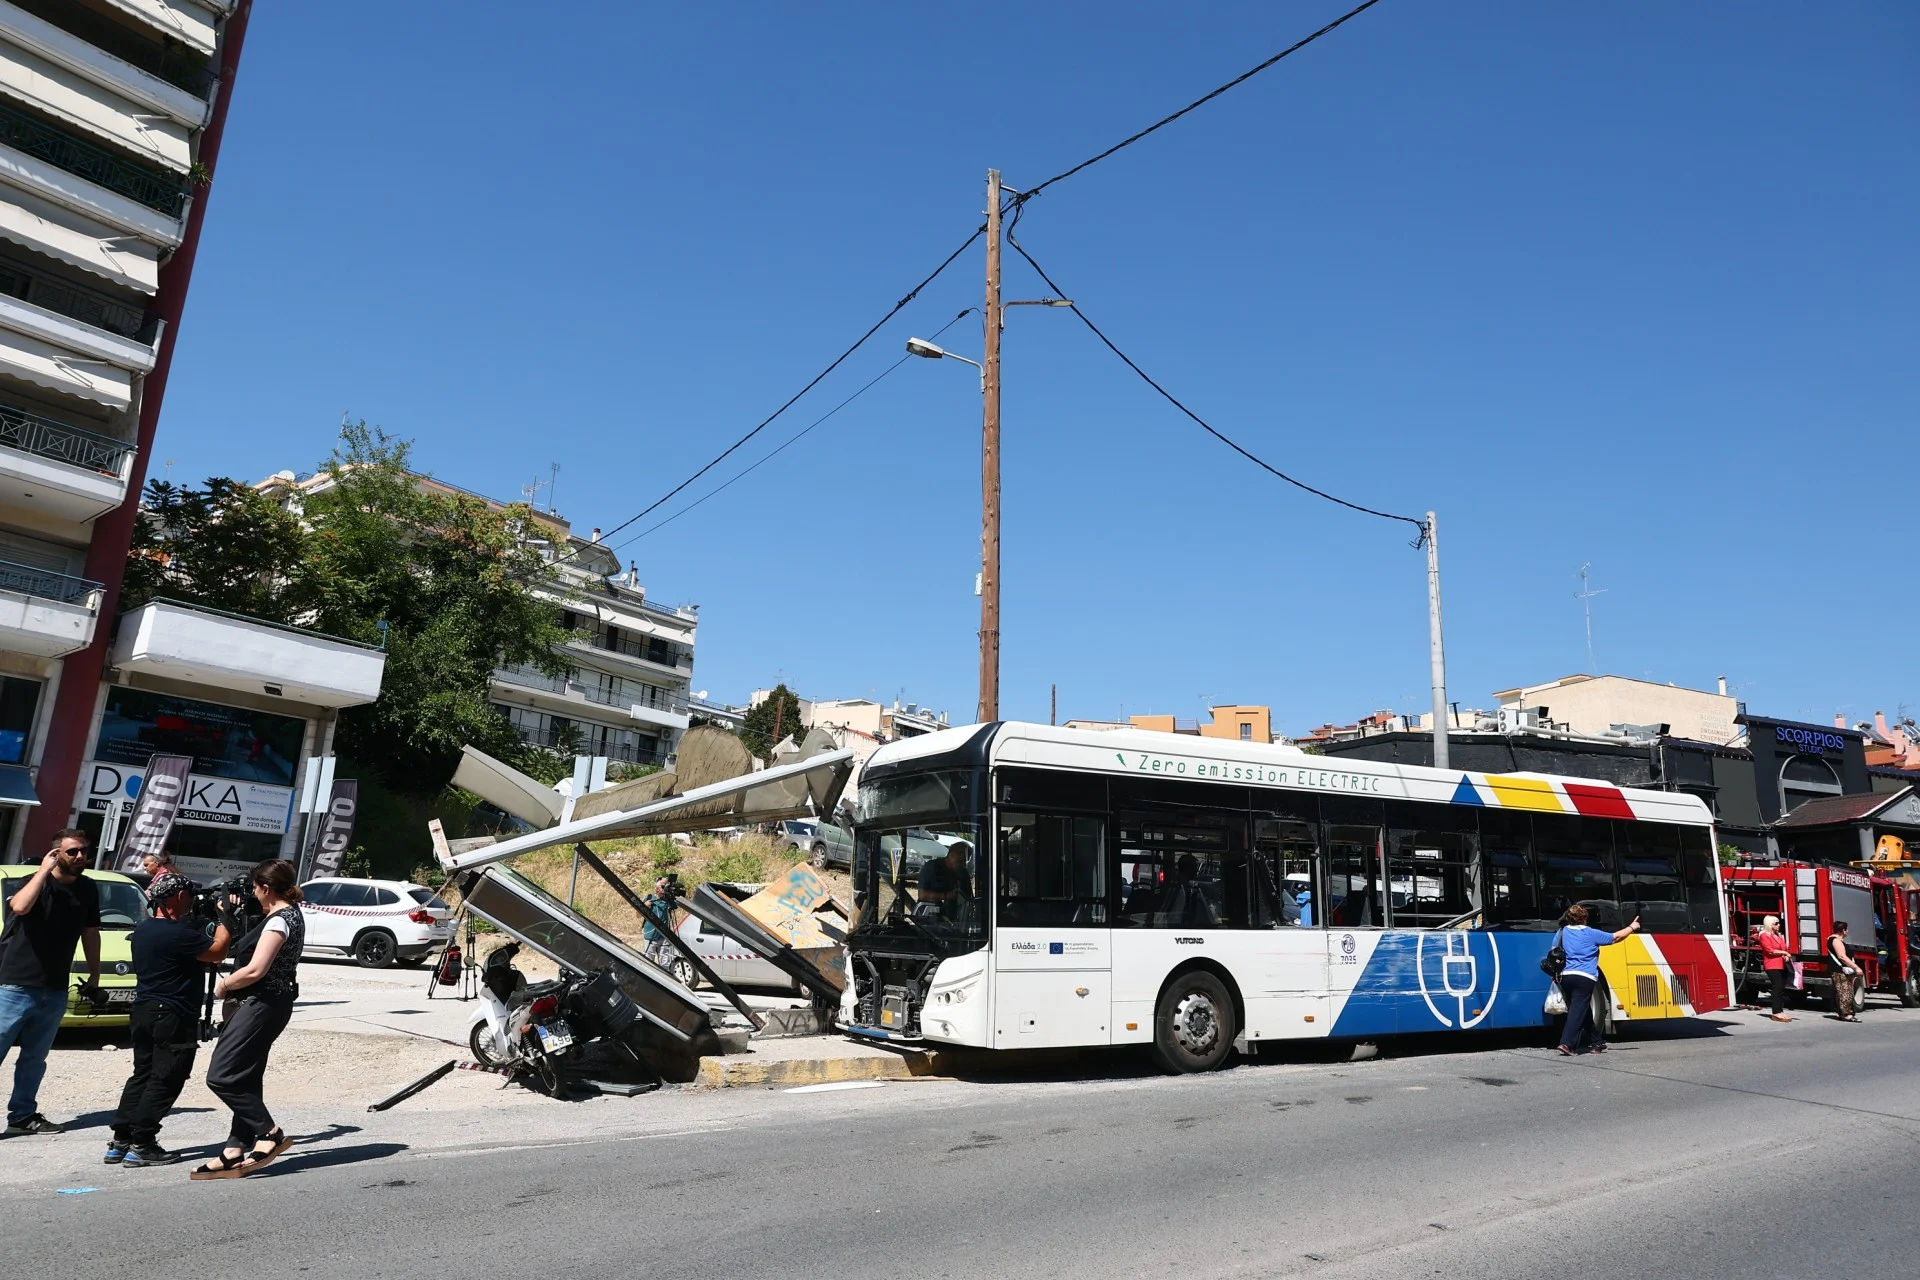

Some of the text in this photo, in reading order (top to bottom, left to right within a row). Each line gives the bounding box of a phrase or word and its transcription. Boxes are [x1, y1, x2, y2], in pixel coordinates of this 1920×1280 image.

[1776, 727, 1844, 749] SCORPIOS
[1798, 744, 1824, 754] STUDIO
[1138, 755, 1380, 792] Zero emission ELECTRIC
[183, 810, 233, 823] SOLUTIONS
[246, 816, 282, 824] www.domka.gr
[1011, 942, 1036, 950] Ελλάδα
[1174, 937, 1205, 945] YUTONG
[1340, 955, 1357, 965] 7035
